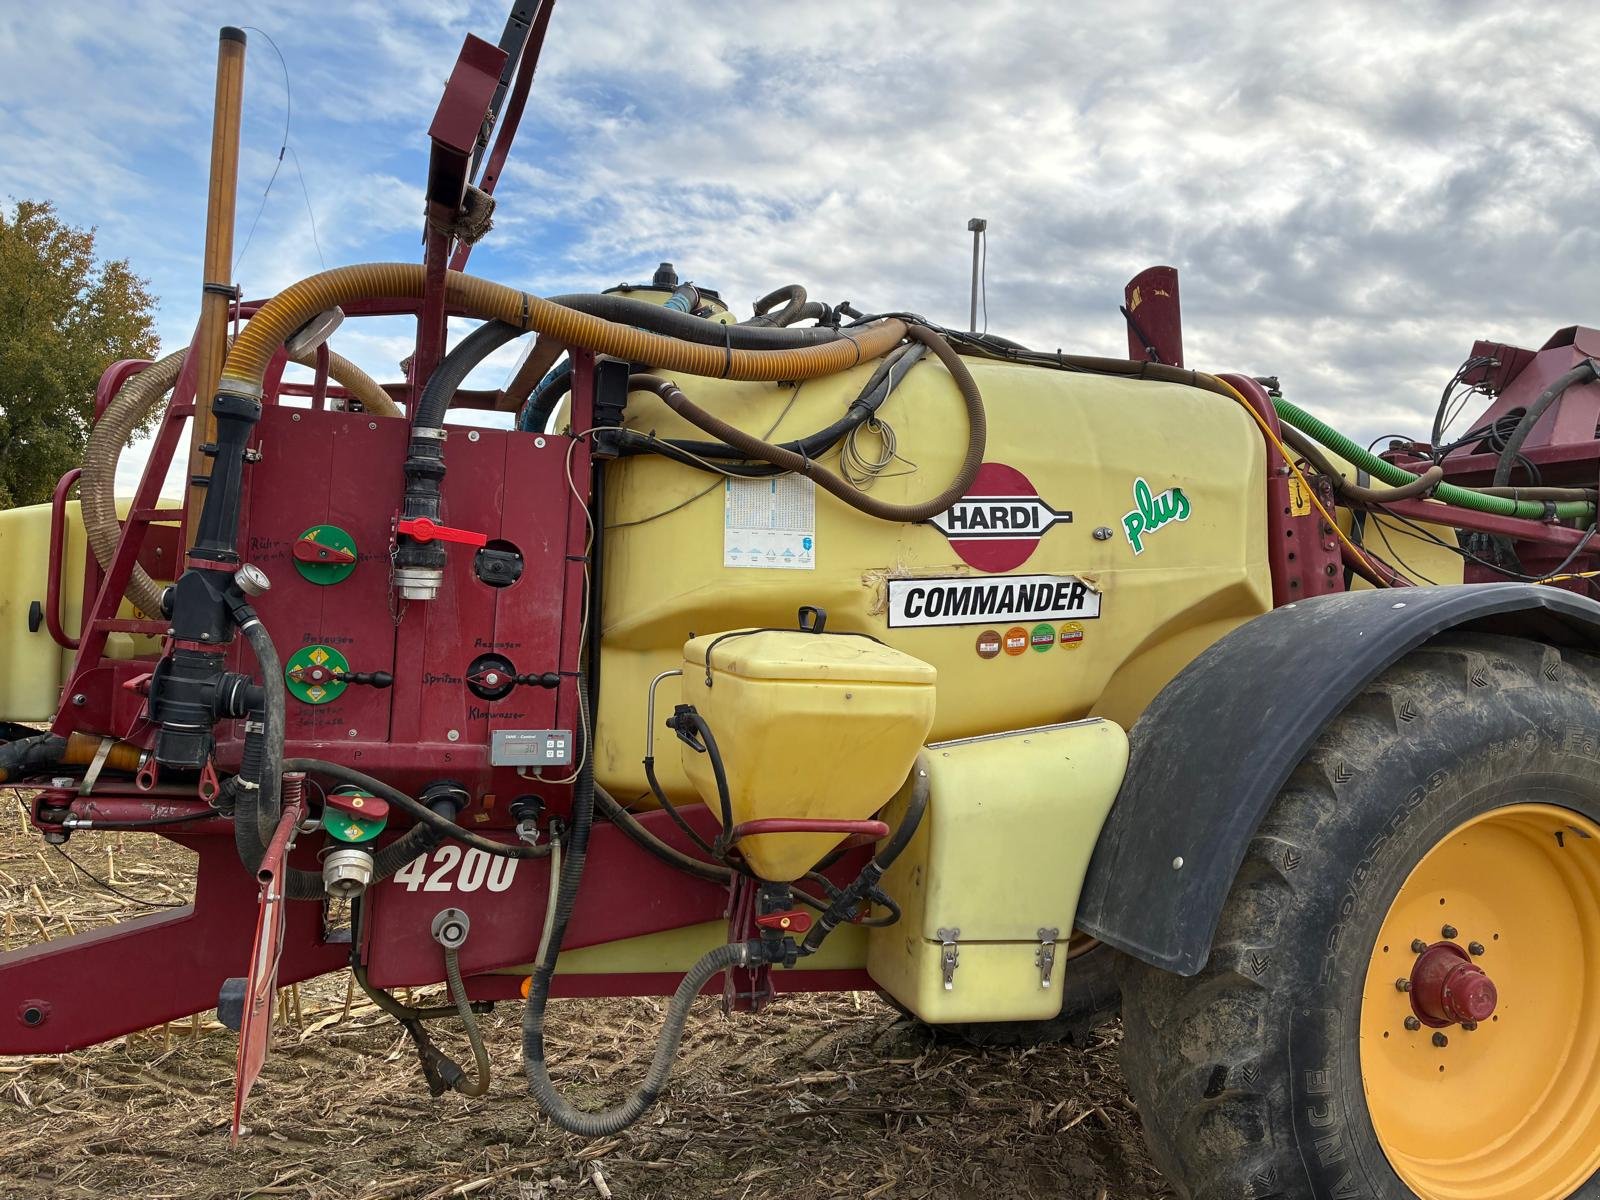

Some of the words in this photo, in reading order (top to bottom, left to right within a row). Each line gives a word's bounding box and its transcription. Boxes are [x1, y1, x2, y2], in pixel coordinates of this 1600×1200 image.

[948, 506, 1040, 530] HARDI
[1124, 480, 1190, 552] plus
[904, 582, 1088, 619] COMMANDER
[423, 672, 463, 686] Spritzen
[353, 750, 362, 761] P
[393, 845, 519, 892] 4200
